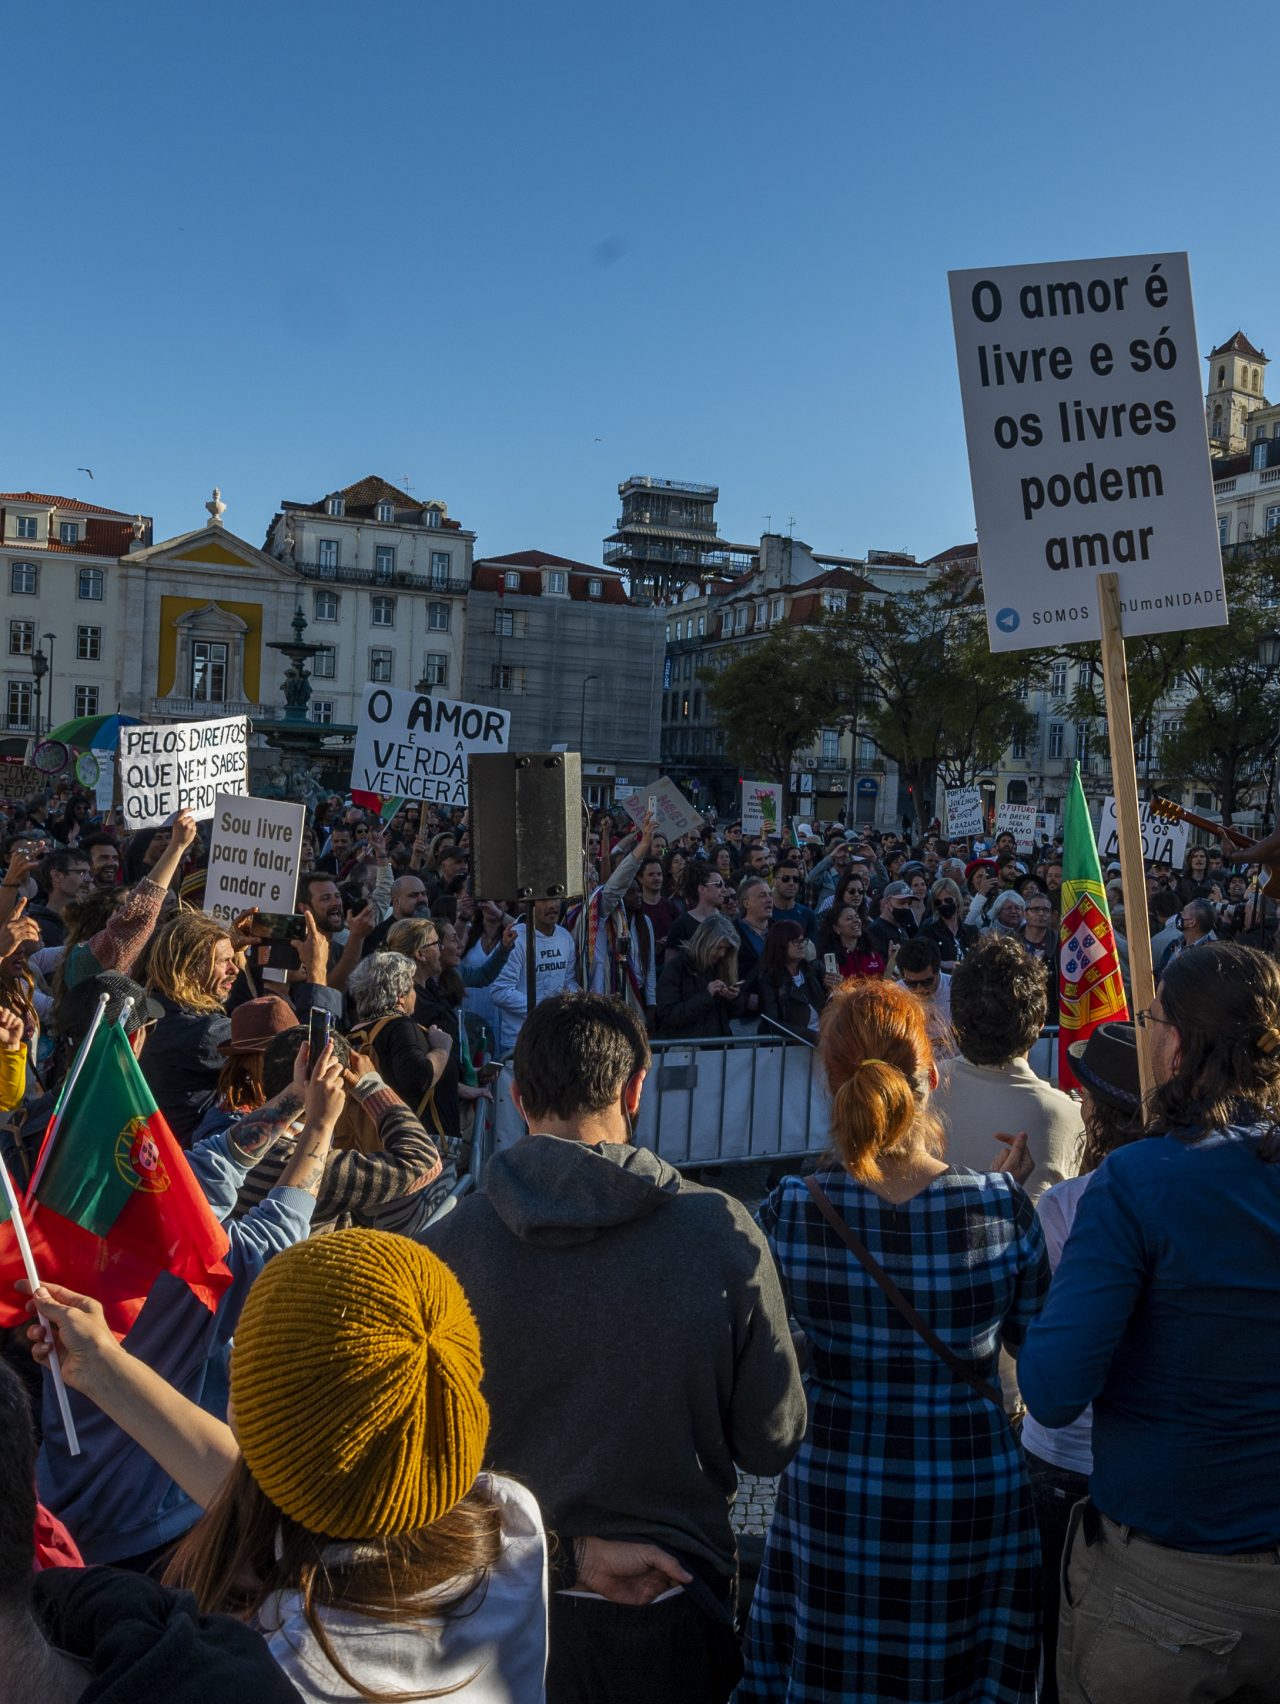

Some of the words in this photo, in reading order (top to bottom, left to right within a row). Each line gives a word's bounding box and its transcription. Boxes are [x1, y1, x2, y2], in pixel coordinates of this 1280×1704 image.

[971, 280, 1003, 323] O
[1019, 276, 1129, 319] amor
[1144, 263, 1169, 308] é
[977, 343, 1073, 387] livre
[1089, 342, 1114, 376] e
[1129, 325, 1178, 373] só
[993, 412, 1044, 450] os
[1058, 399, 1177, 443] livres
[1020, 462, 1164, 521] podem
[1045, 525, 1154, 571] amar
[1032, 606, 1090, 625] SOMOS
[368, 689, 393, 724] O
[407, 695, 505, 745] AMOR
[127, 730, 186, 755] PELOS
[189, 723, 247, 752] DIREITOS
[408, 733, 417, 745] E
[455, 740, 464, 752] A
[127, 763, 173, 788] QUE
[177, 757, 207, 785] NEM
[210, 751, 246, 777] SABES
[373, 739, 466, 779] VERDA
[127, 792, 171, 820] QUE
[1007, 804, 1036, 814] FUTURO
[221, 812, 251, 836] Sou
[256, 818, 293, 842] livre
[1152, 825, 1170, 836] OS
[212, 843, 248, 865] para
[253, 847, 294, 876] falar,
[219, 874, 266, 899] andar
[270, 883, 281, 901] e
[540, 949, 561, 959] PELA
